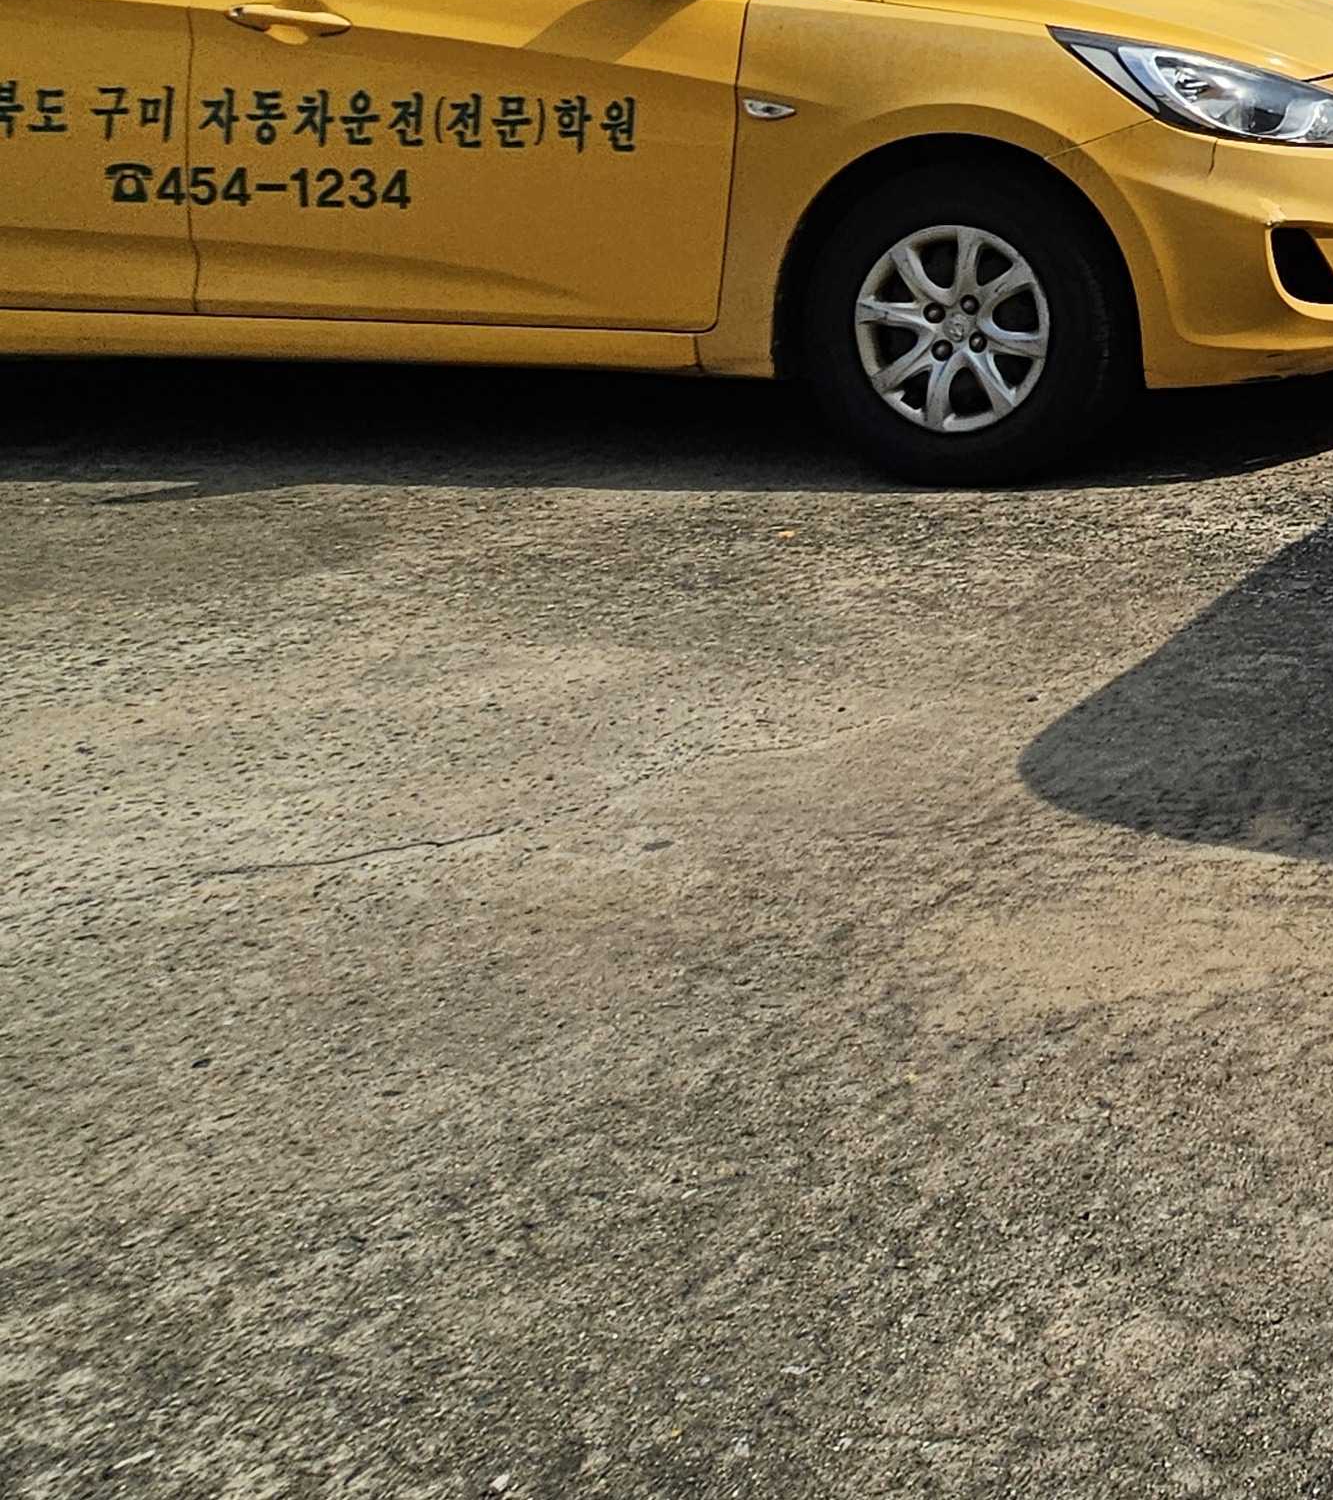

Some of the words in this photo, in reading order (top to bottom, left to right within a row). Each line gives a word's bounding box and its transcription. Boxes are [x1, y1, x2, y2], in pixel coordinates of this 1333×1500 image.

[90, 84, 175, 143] 구미
[200, 87, 637, 153] 자동차운전(전문)학원
[156, 165, 412, 209] 454-1234
